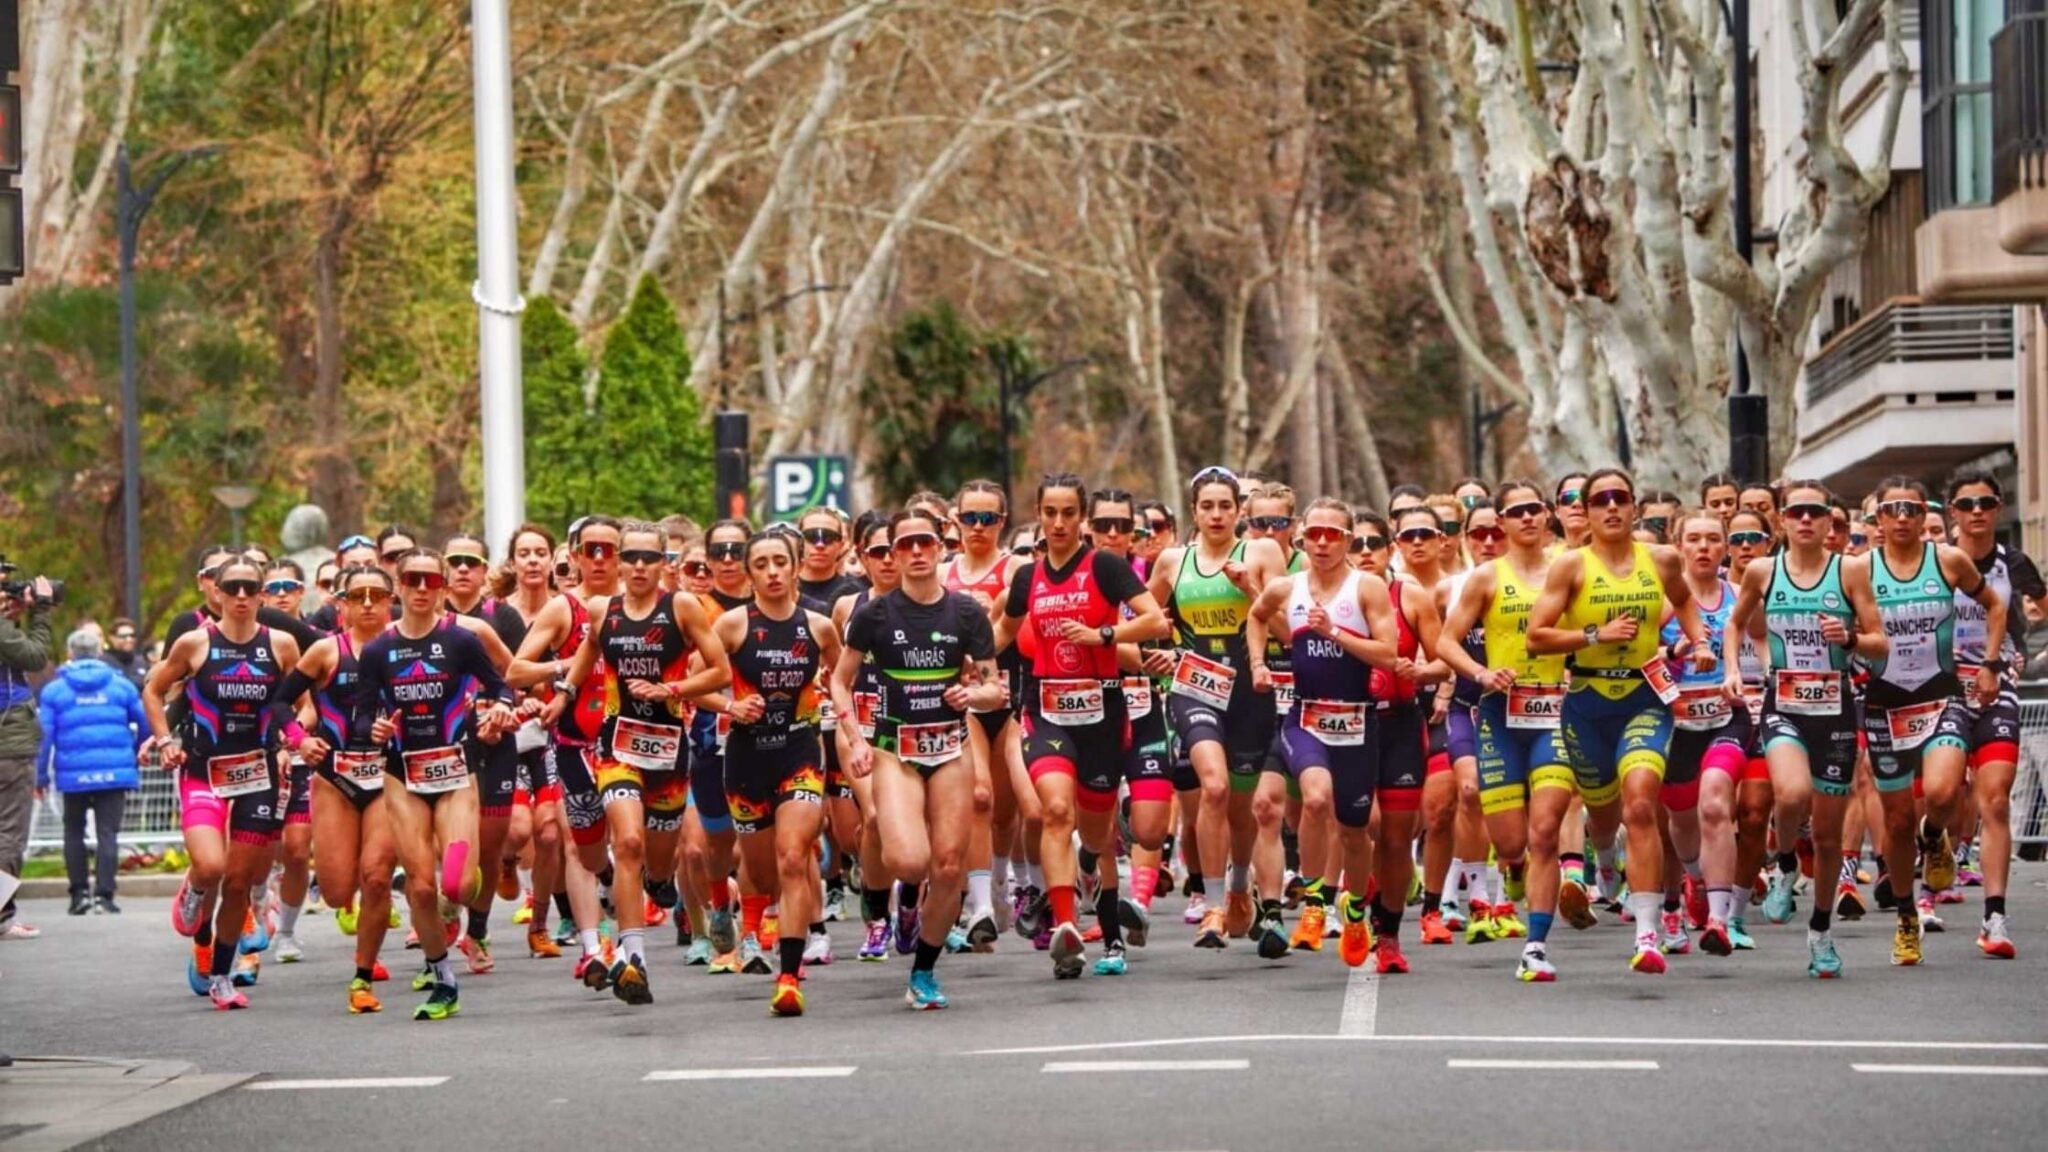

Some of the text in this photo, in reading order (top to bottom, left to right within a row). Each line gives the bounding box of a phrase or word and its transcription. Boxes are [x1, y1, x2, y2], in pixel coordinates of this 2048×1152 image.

[775, 462, 813, 512] P
[1192, 608, 1238, 629] AULINAS
[1784, 629, 1828, 648] PEIRATS
[903, 646, 946, 668] VIÑARÁS
[617, 656, 661, 676] ACOSTA
[1189, 671, 1217, 692] 57A
[218, 682, 268, 701] NAVARRO
[394, 681, 444, 702] REIMONDO
[1794, 687, 1824, 700] 52B
[1057, 697, 1087, 710] 58A
[1524, 702, 1553, 714] 60A
[1687, 702, 1717, 717] 51C
[1318, 718, 1348, 732] 64A
[631, 738, 662, 755] 53C
[917, 739, 946, 754] 61J
[226, 767, 253, 782] 55F
[351, 764, 379, 778] 55G
[424, 764, 449, 779] 55I
